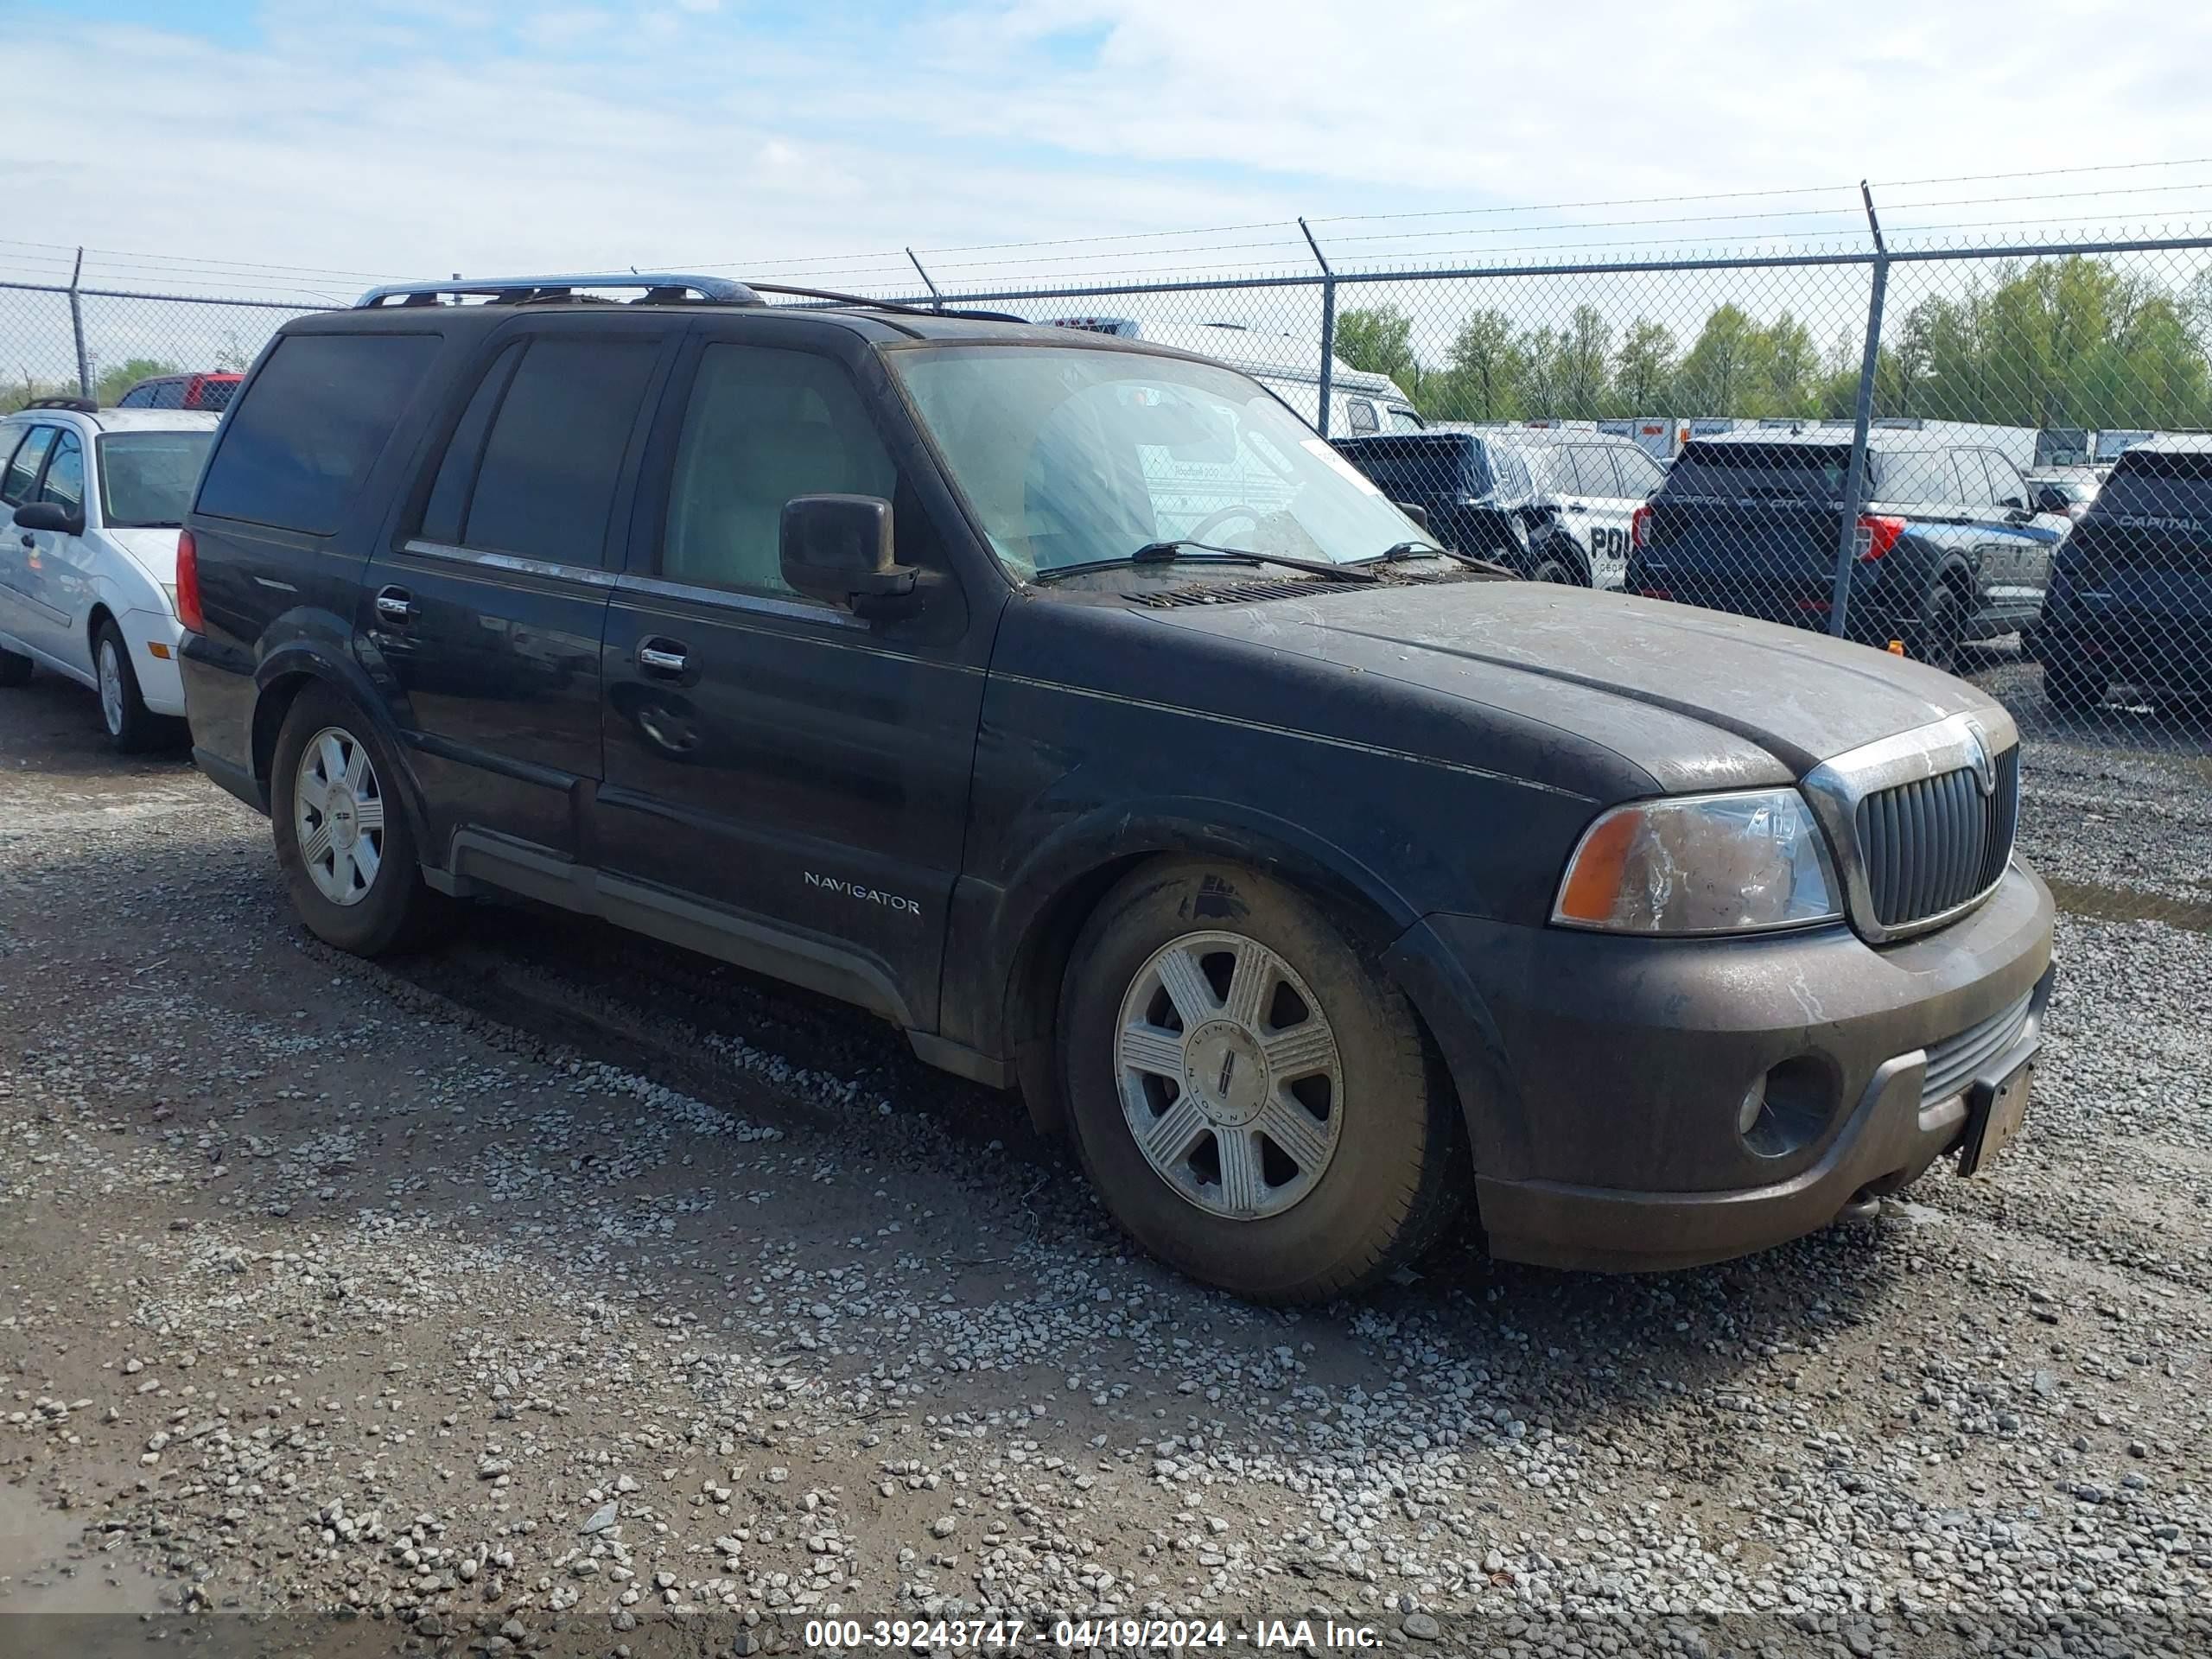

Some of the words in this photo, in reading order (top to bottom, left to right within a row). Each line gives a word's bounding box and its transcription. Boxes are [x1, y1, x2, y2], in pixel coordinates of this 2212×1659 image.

[1672, 494, 1727, 505] CAPITAL
[2119, 515, 2203, 531] CAPITAL
[804, 871, 921, 916] NAVIGATOR
